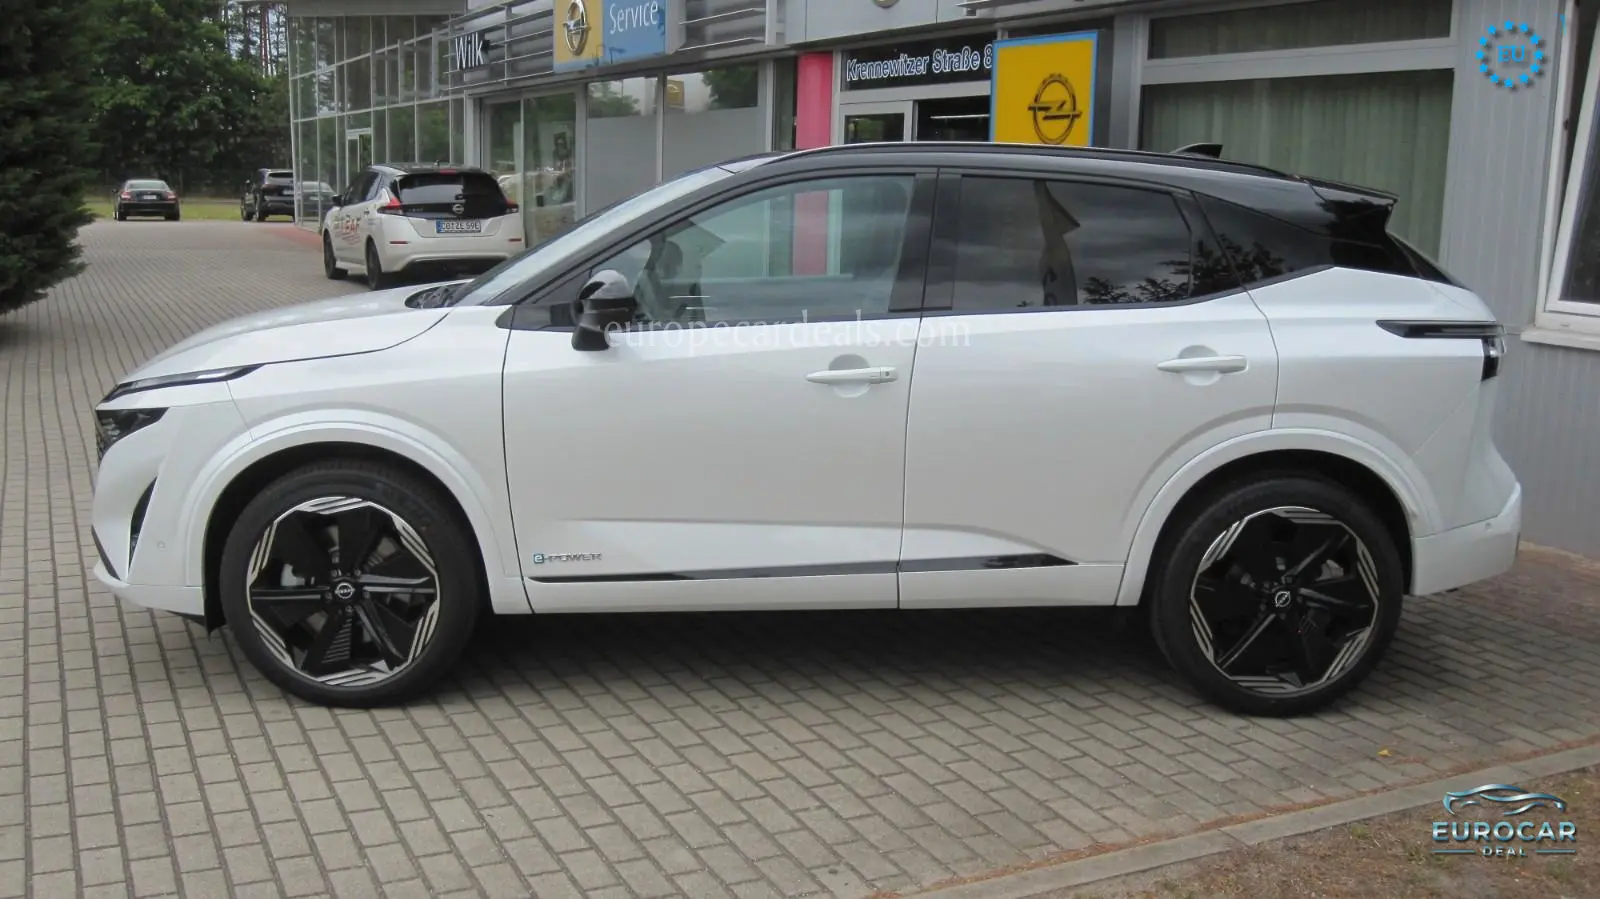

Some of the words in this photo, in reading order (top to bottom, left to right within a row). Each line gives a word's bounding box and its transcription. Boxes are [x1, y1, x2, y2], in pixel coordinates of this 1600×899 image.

[609, 1, 659, 35] Service
[455, 31, 485, 70] Wilk
[847, 53, 929, 82] Krennewitzer
[932, 46, 981, 73] Straße
[533, 552, 602, 564] e-POWER
